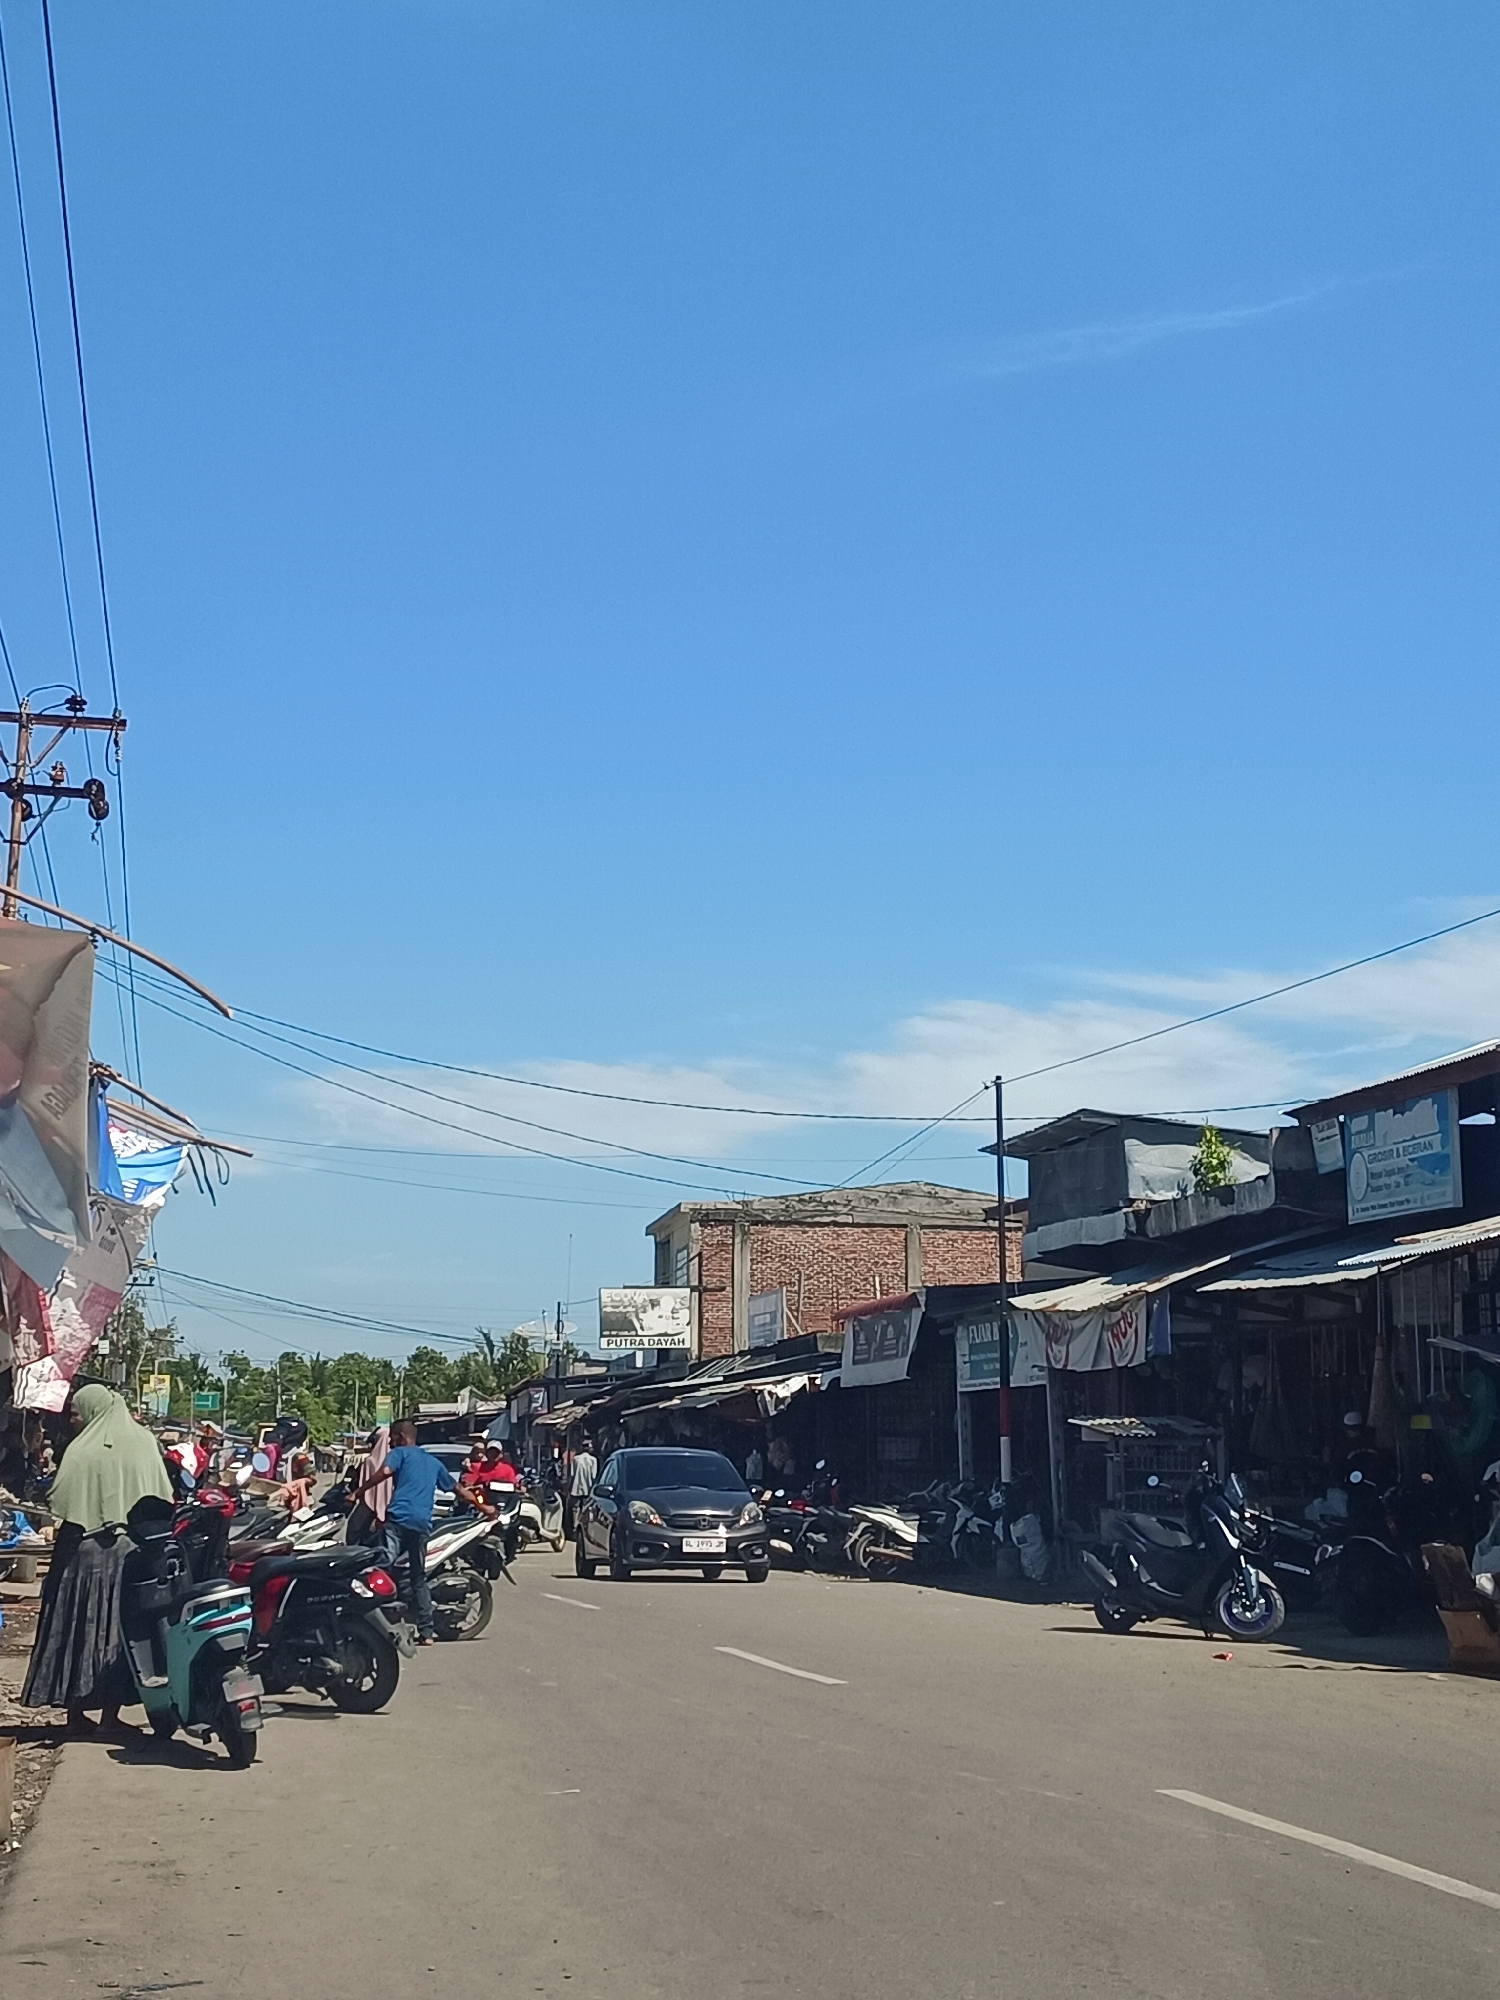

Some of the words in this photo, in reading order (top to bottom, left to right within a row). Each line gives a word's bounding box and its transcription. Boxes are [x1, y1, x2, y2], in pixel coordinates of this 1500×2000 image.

[1367, 1149, 1394, 1165] GROSIR
[1402, 1140, 1434, 1157] ECERAN
[606, 1338, 645, 1347] PUTRA
[648, 1338, 685, 1347] DAYAH
